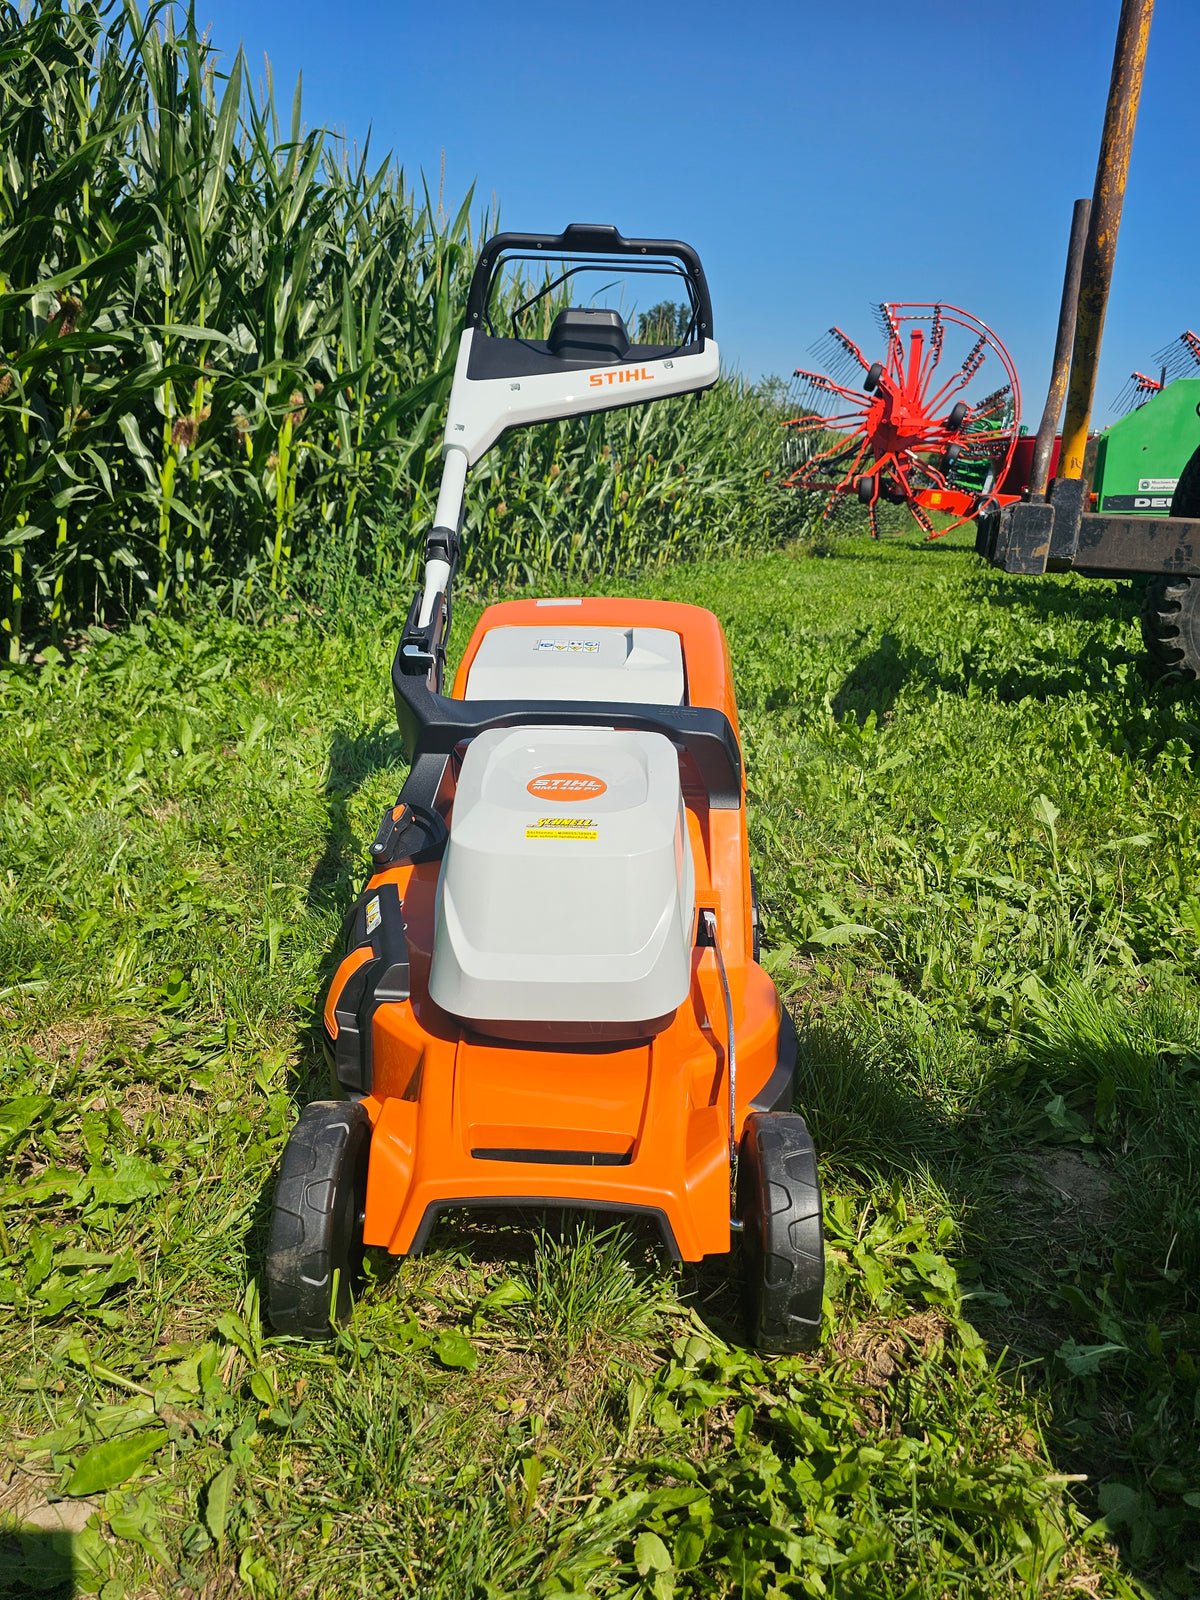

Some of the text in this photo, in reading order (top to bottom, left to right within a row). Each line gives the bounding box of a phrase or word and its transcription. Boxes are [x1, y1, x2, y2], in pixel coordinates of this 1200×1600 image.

[589, 368, 655, 387] STIHL
[532, 779, 602, 787] STIHL
[537, 818, 593, 827] SCHNELL
